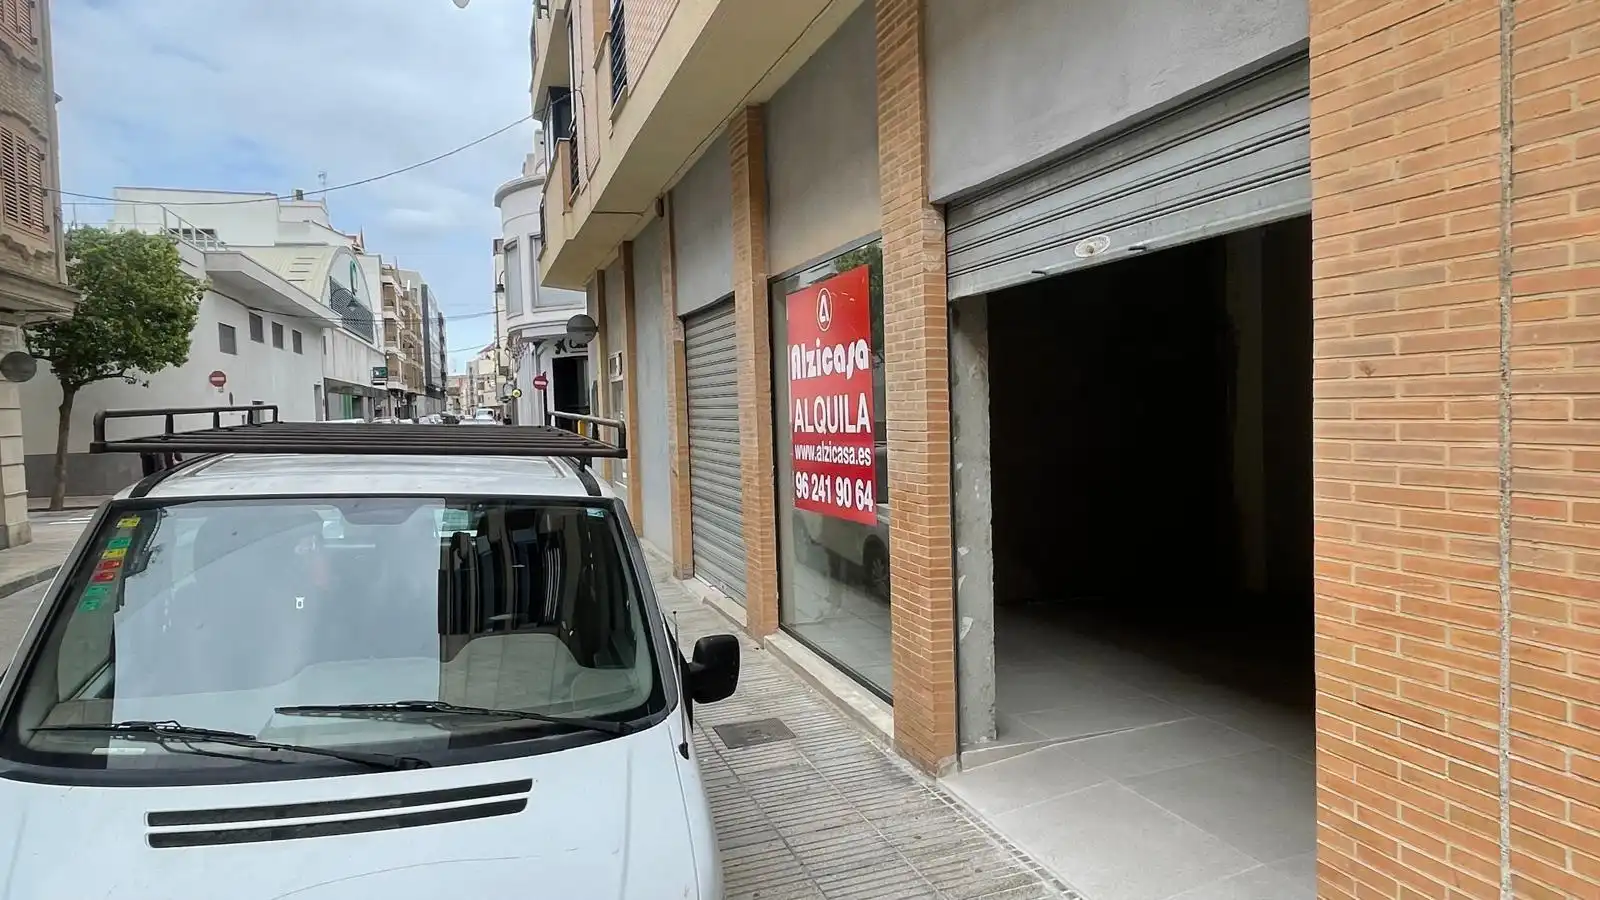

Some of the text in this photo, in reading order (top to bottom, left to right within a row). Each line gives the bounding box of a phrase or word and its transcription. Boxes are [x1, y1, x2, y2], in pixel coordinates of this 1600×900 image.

[791, 337, 869, 380] Alzicasa
[793, 393, 872, 434] ALQUILA
[794, 441, 872, 466] www.alzicasa.es
[795, 471, 874, 512] 96 241 90 64
